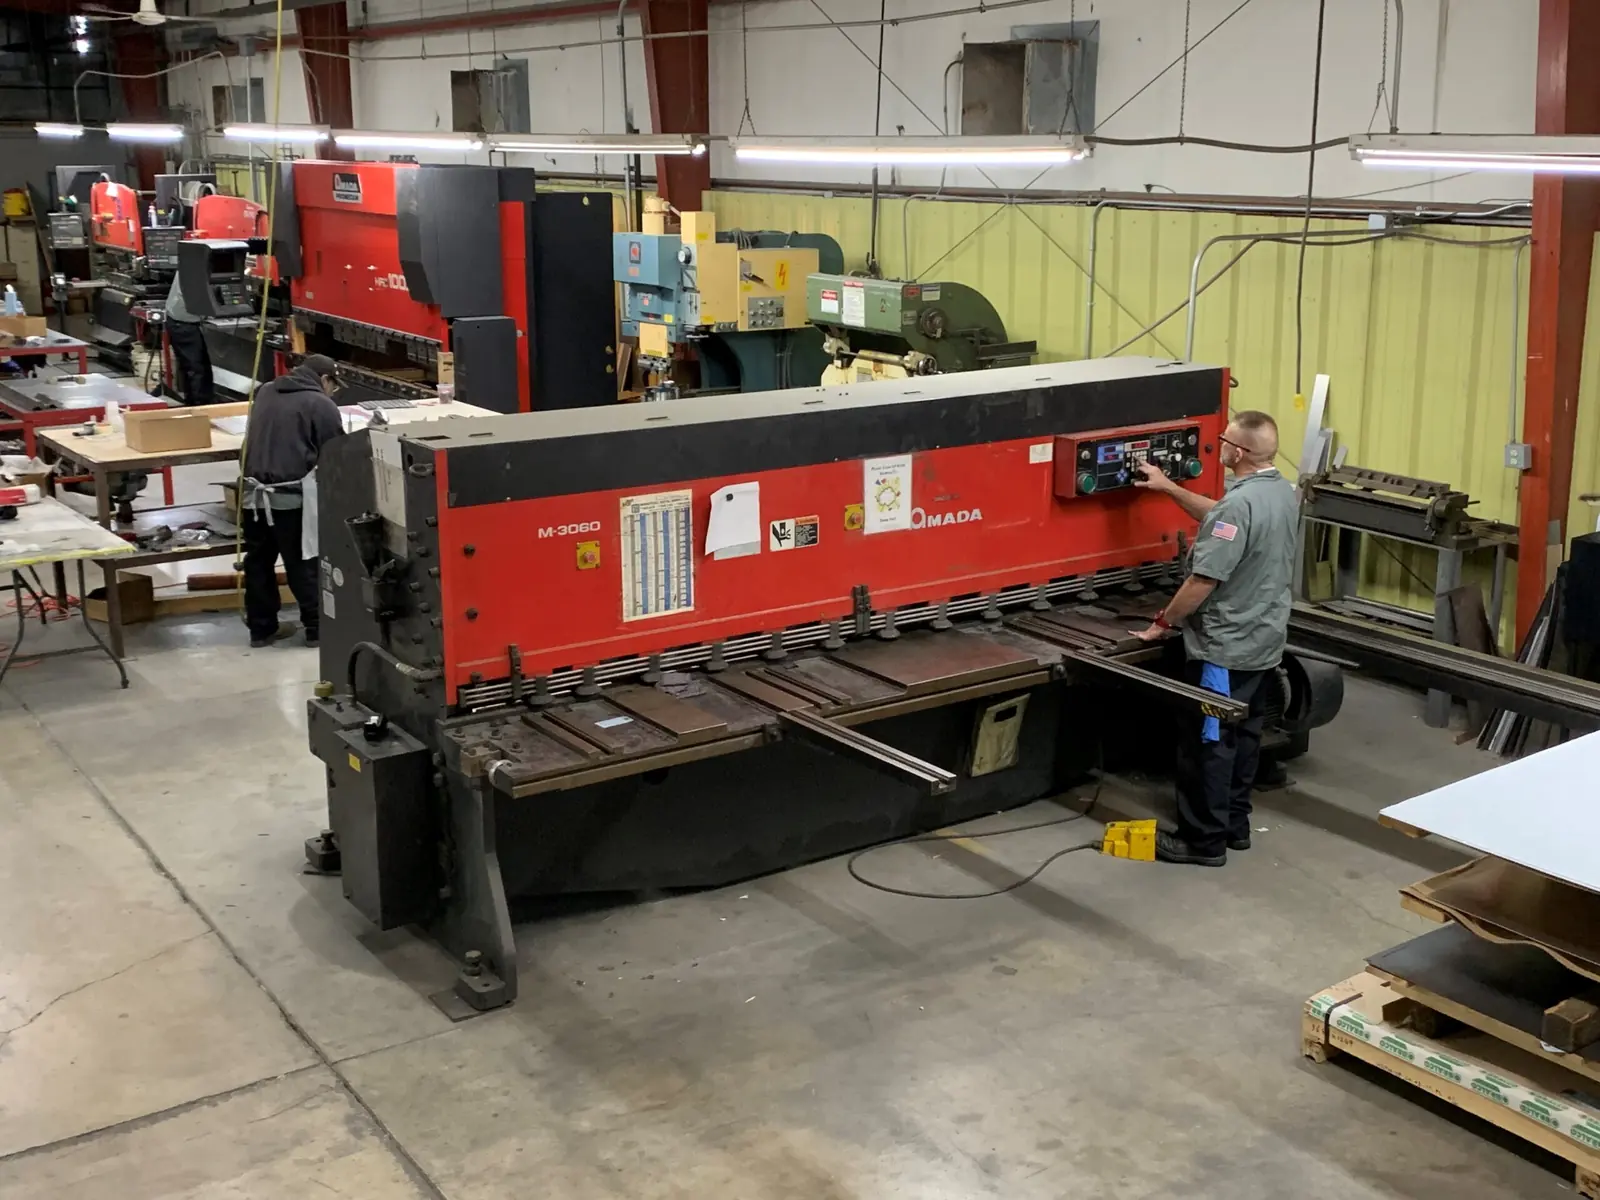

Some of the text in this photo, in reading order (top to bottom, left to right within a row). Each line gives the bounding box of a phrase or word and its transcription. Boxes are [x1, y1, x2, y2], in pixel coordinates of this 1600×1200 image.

[911, 507, 983, 529] AMADA
[538, 521, 601, 539] M-3060
[1336, 1019, 1364, 1037] BRALCO
[1379, 1039, 1408, 1058] BRALCO
[1424, 1059, 1454, 1080] BRALCO
[1471, 1081, 1502, 1102] BRALCO
[1519, 1104, 1551, 1125] BRALCO
